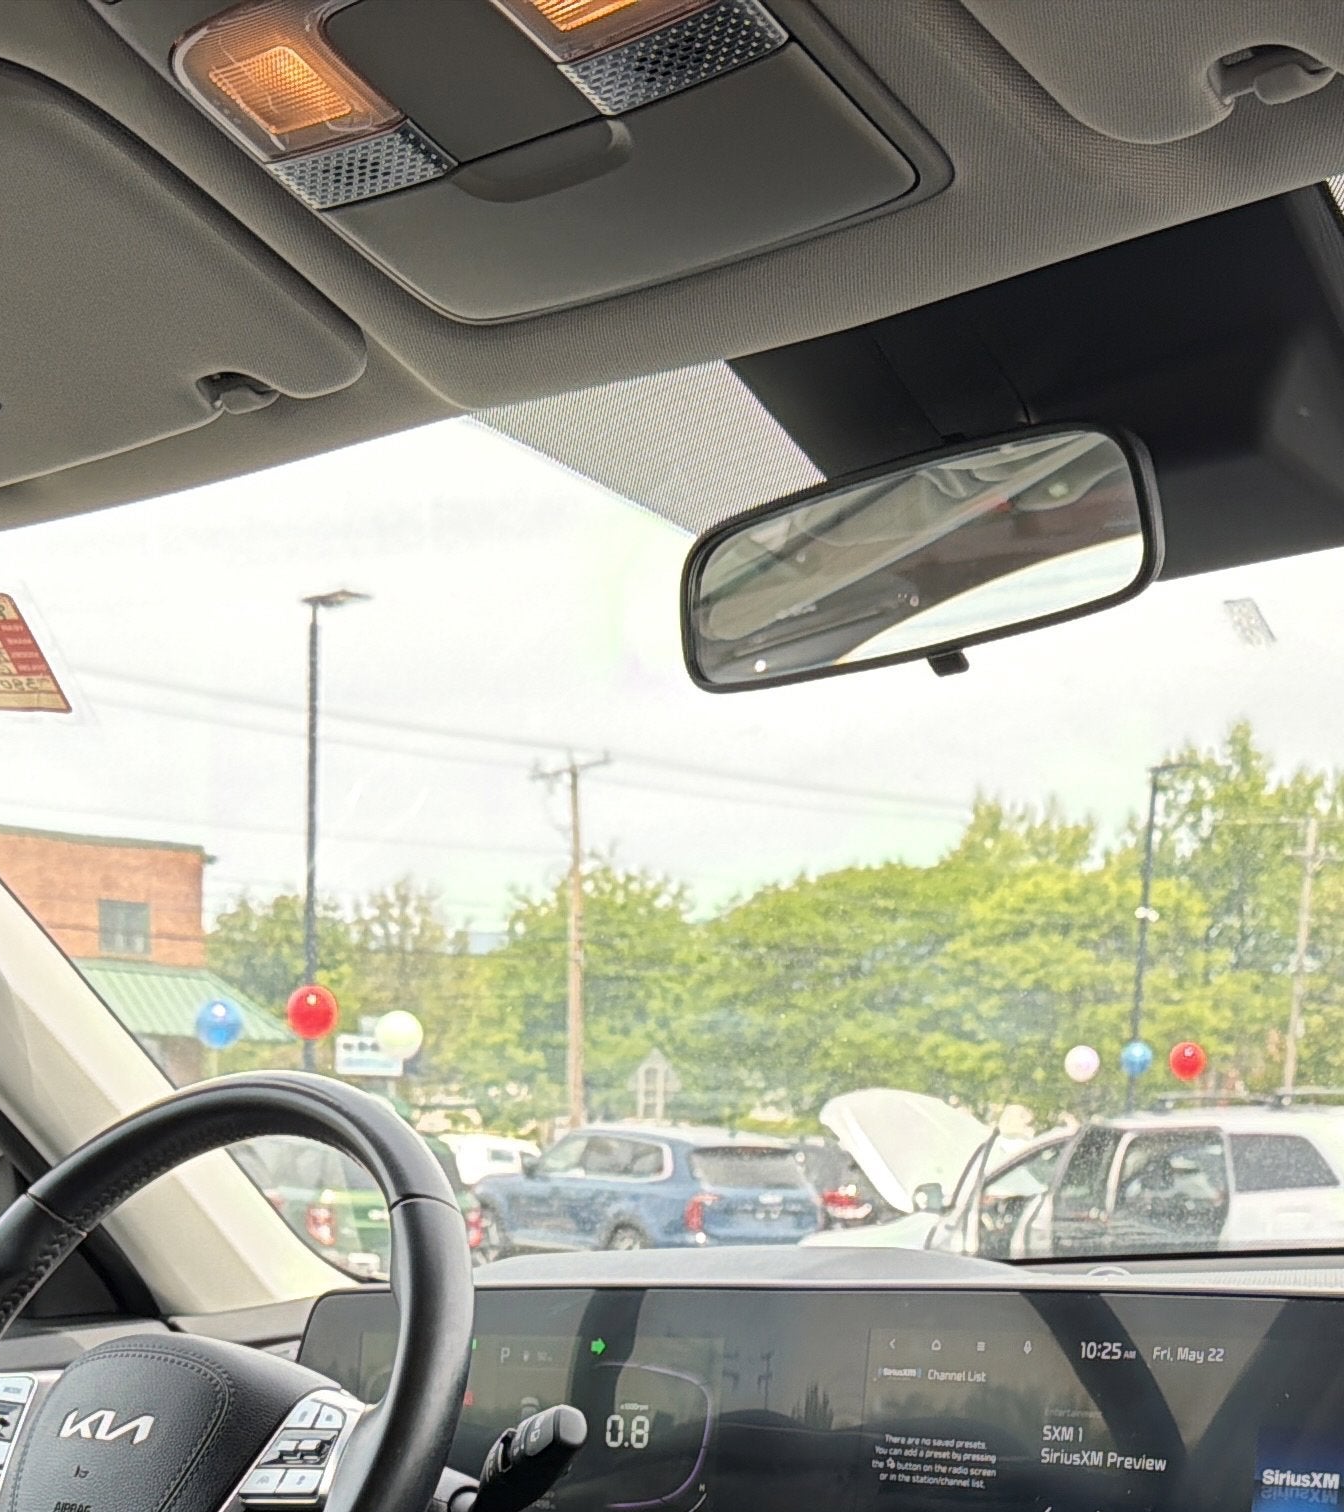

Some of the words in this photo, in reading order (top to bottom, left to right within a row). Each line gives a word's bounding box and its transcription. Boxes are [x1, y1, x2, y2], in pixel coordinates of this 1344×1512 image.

[1080, 1341, 1122, 1360] 10:25
[1123, 1350, 1136, 1359] AM
[1177, 1348, 1204, 1363] May
[1208, 1348, 1225, 1362] 22
[928, 1368, 966, 1381] Channel
[968, 1370, 986, 1382] List
[606, 1414, 650, 1449] 0.8
[885, 1434, 905, 1444] There
[921, 1438, 931, 1446] no
[932, 1439, 954, 1447] saved
[1042, 1425, 1074, 1442] SXM
[1078, 1427, 1084, 1442] 1
[875, 1445, 887, 1455] You
[889, 1447, 902, 1455] can
[904, 1448, 918, 1457] add
[925, 1450, 950, 1459] preset
[951, 1452, 961, 1461] by
[963, 1453, 996, 1464] pressing
[1040, 1448, 1103, 1468] SiriusXM
[1106, 1452, 1167, 1472] Preview
[872, 1459, 884, 1468] the
[897, 1461, 921, 1471] button
[923, 1464, 933, 1472] on
[934, 1464, 947, 1473] the
[948, 1465, 968, 1475] radio
[970, 1468, 996, 1477] screen
[898, 1473, 910, 1482] the
[912, 1475, 970, 1487] station/channel
[1262, 1469, 1340, 1489] SiriusXM
